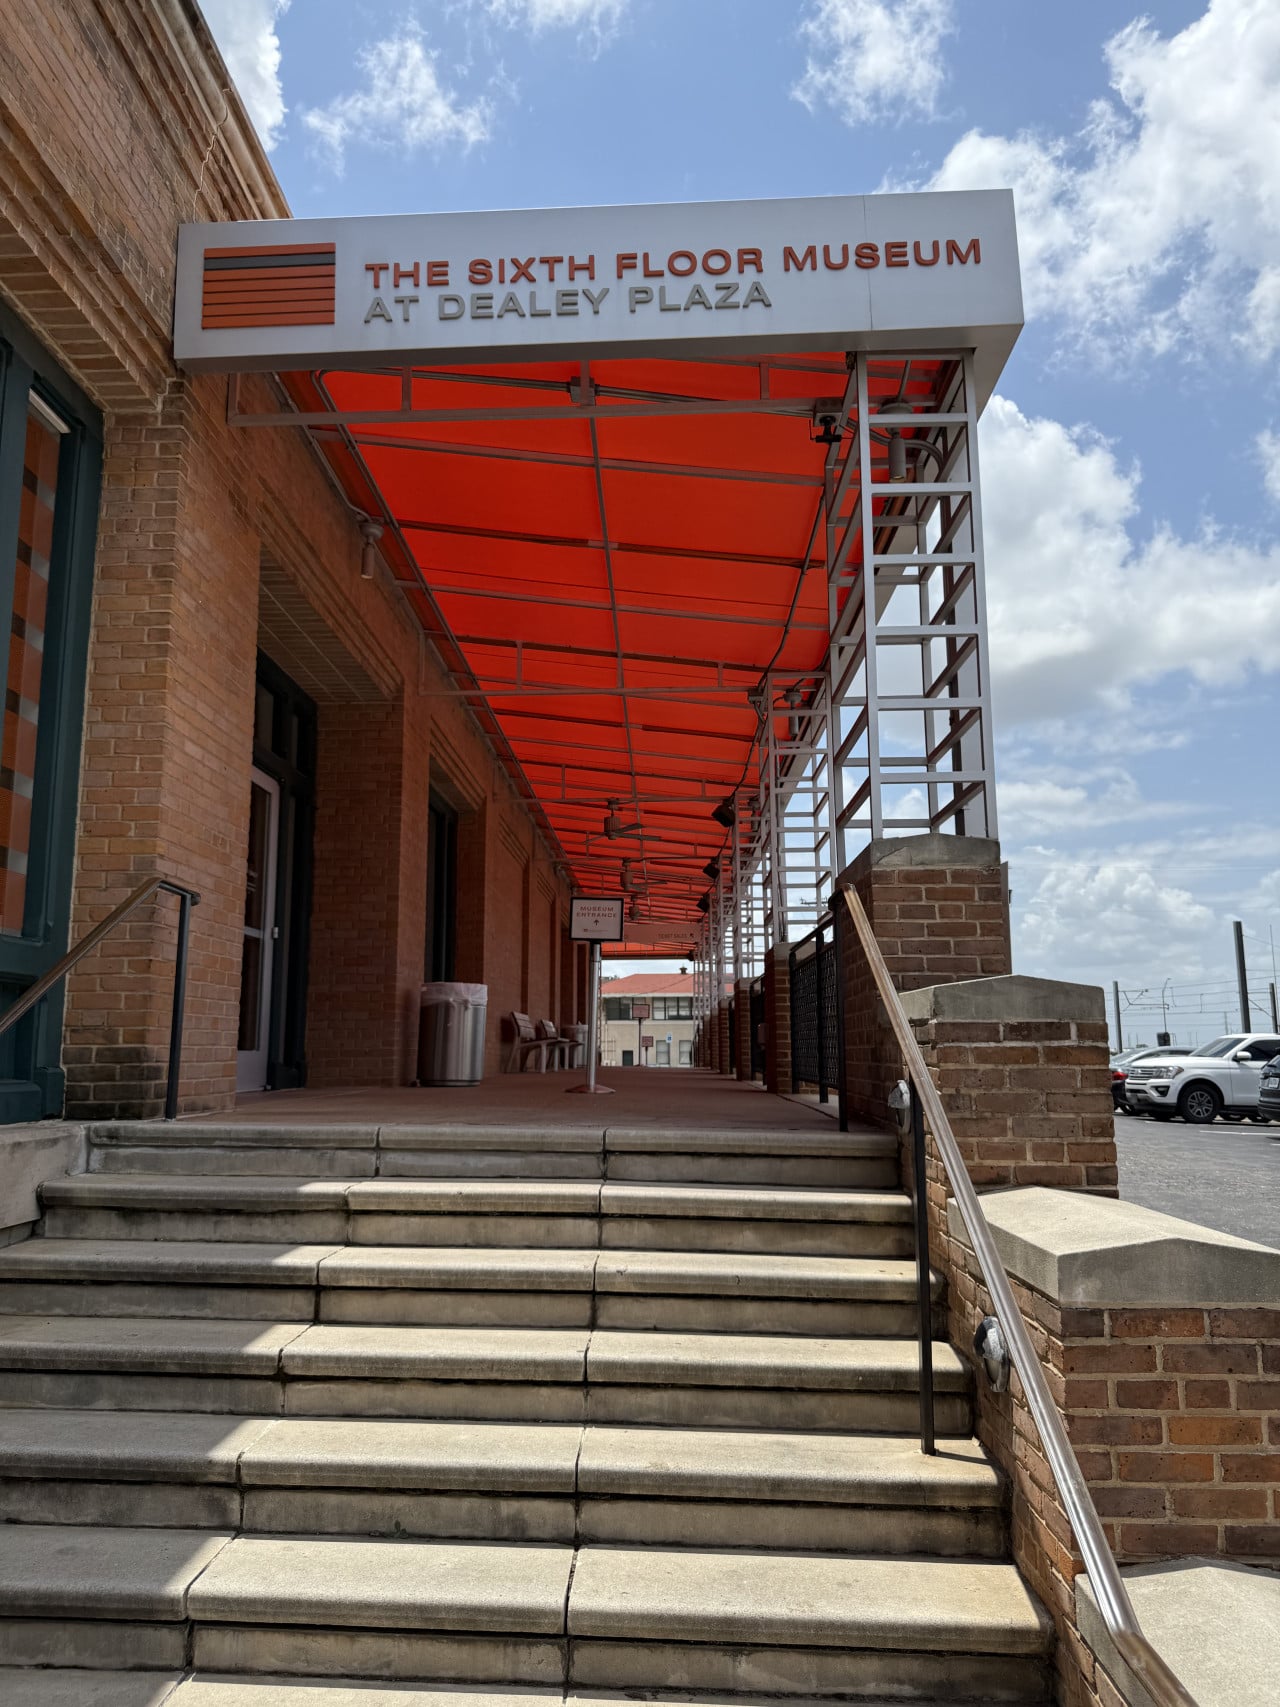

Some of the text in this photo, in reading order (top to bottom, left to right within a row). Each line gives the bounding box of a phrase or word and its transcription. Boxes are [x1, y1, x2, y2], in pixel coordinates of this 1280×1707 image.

[364, 238, 981, 289] THE SIXTH FLOOR MUSEUM
[363, 281, 772, 324] AT DEALEY PLAZA
